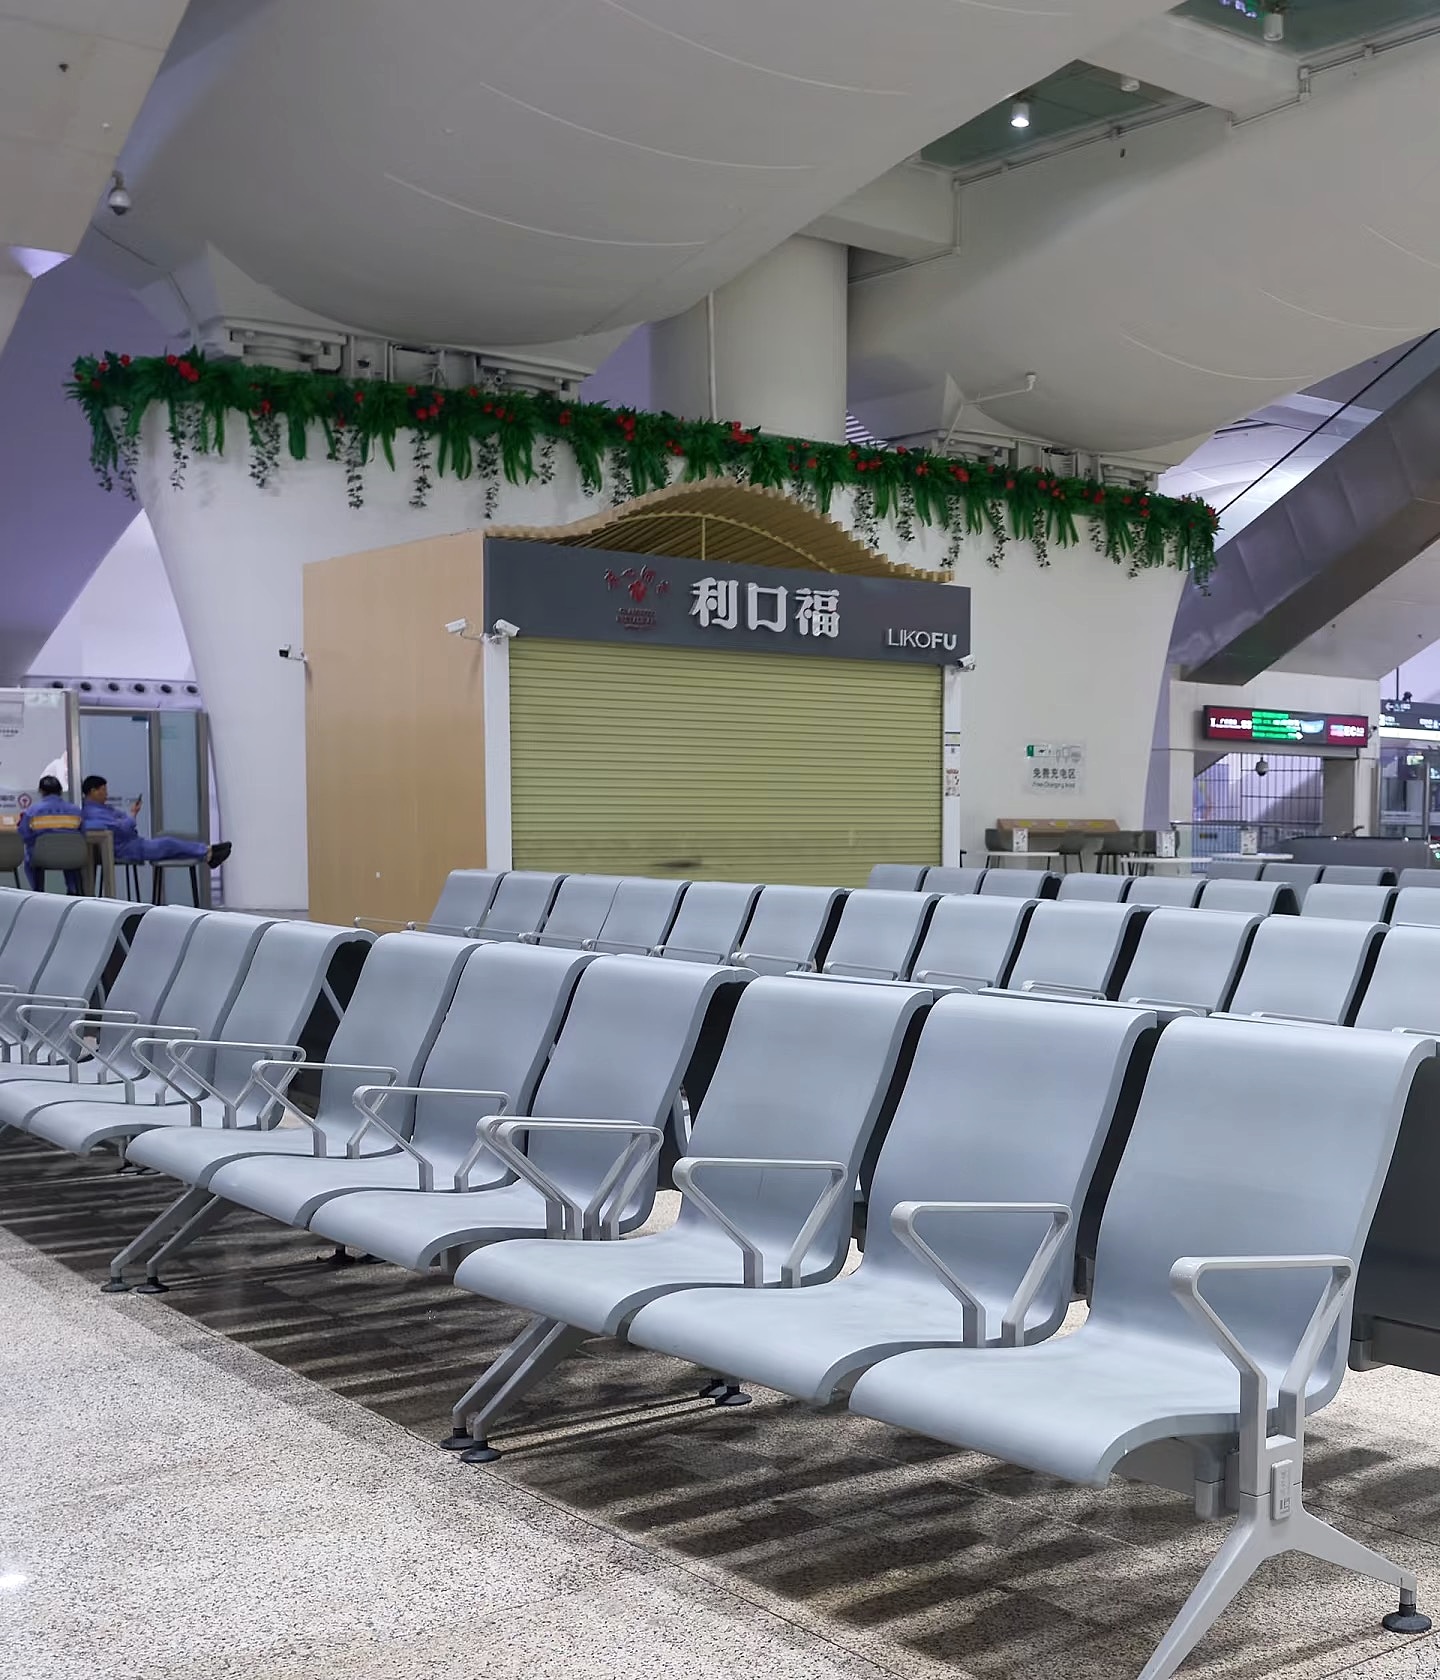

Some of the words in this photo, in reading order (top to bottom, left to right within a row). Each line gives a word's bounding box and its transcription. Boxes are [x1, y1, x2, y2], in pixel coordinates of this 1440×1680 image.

[689, 576, 840, 638] 利口福
[888, 628, 957, 651] LIKOFU
[1032, 767, 1076, 779] 免费充电区
